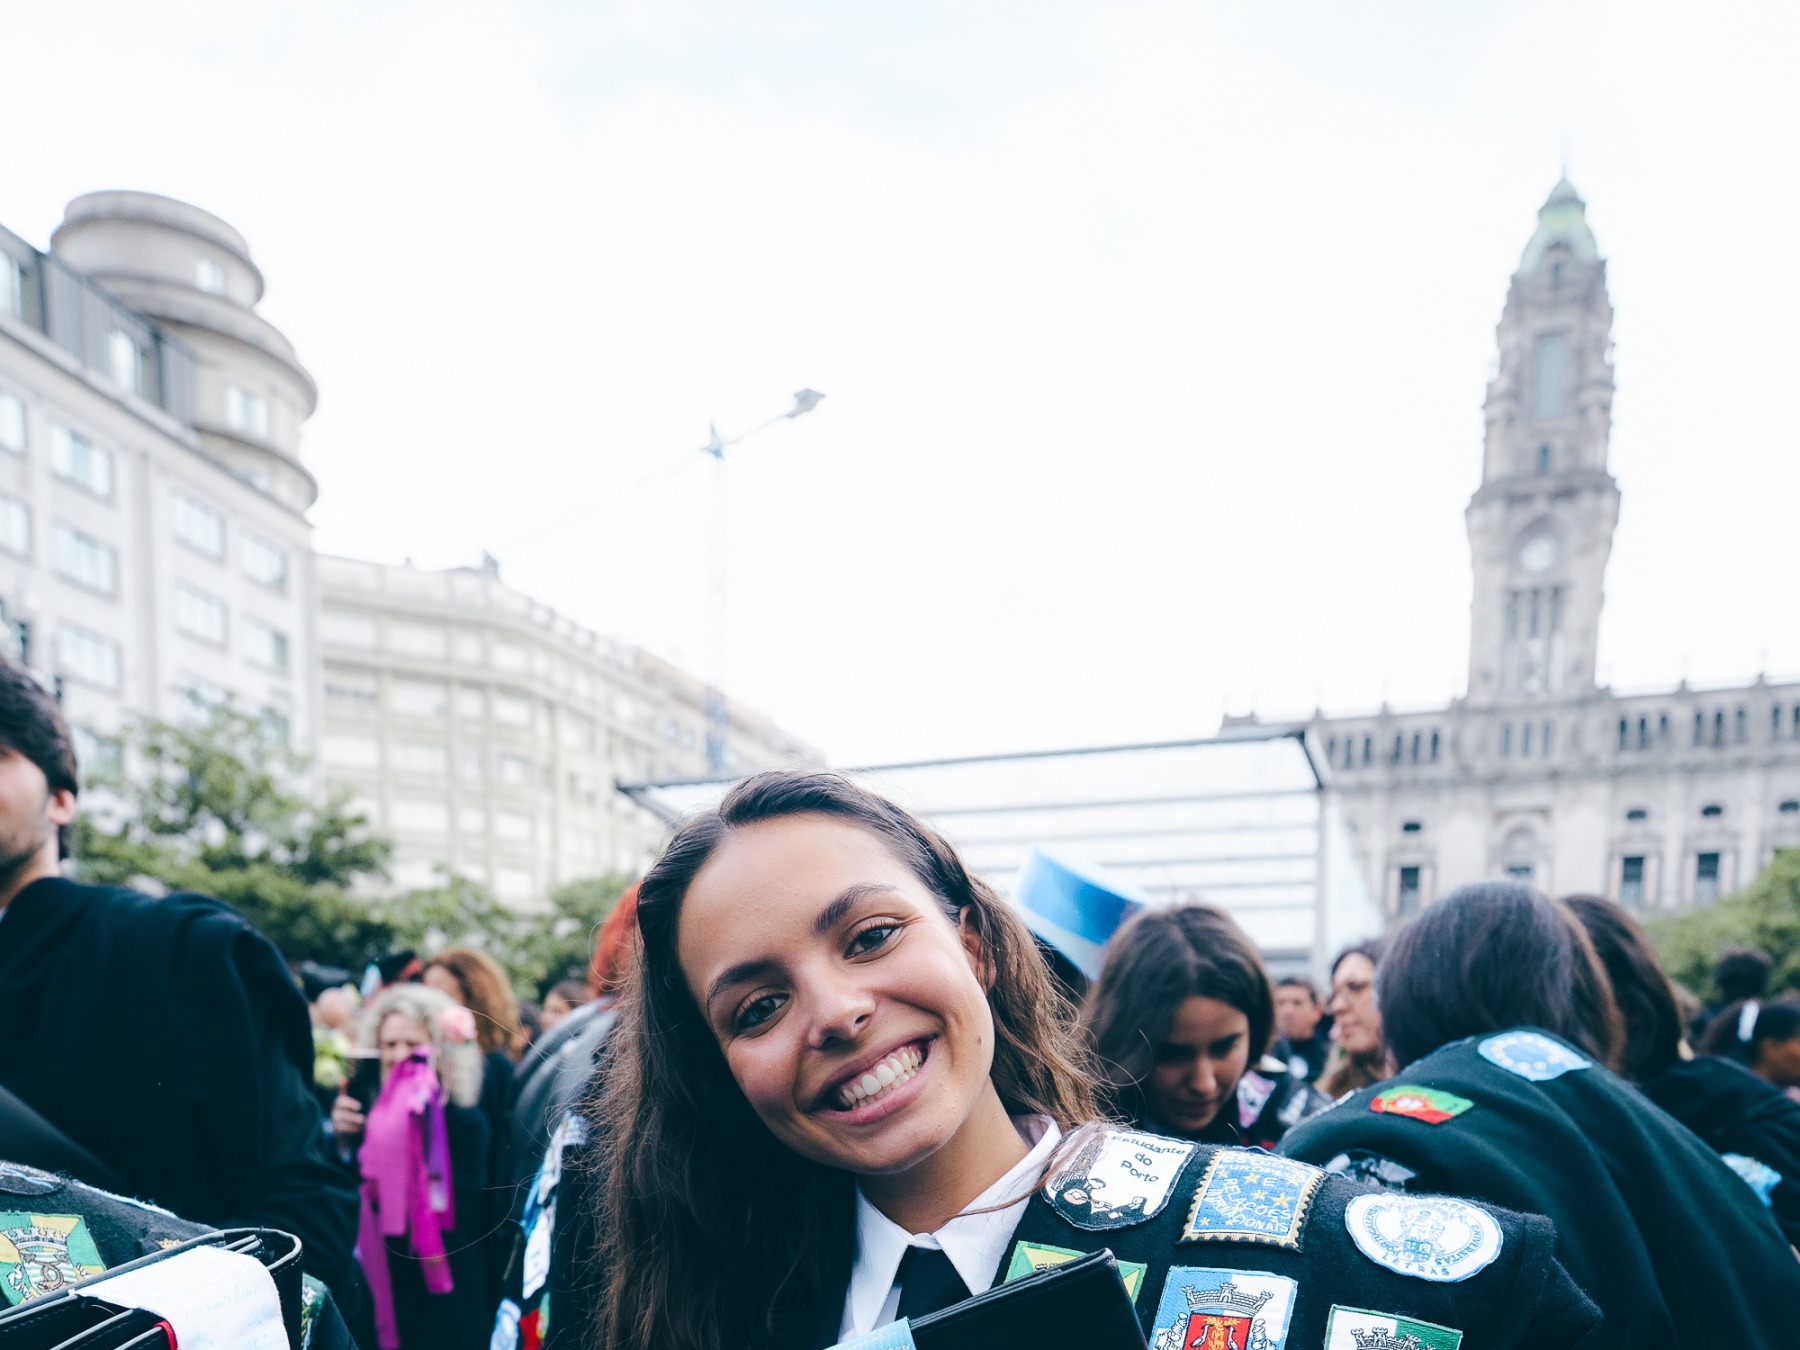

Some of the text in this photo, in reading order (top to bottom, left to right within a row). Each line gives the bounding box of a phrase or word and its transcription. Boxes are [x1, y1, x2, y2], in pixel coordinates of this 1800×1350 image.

[1111, 1135, 1186, 1155] Estudante
[1135, 1152, 1152, 1166] do
[1120, 1160, 1159, 1182] Porto
[1263, 1177, 1277, 1187] E
[1435, 1225, 1482, 1266] UNIVERSITAS
[1382, 1252, 1450, 1276] LETRAS
